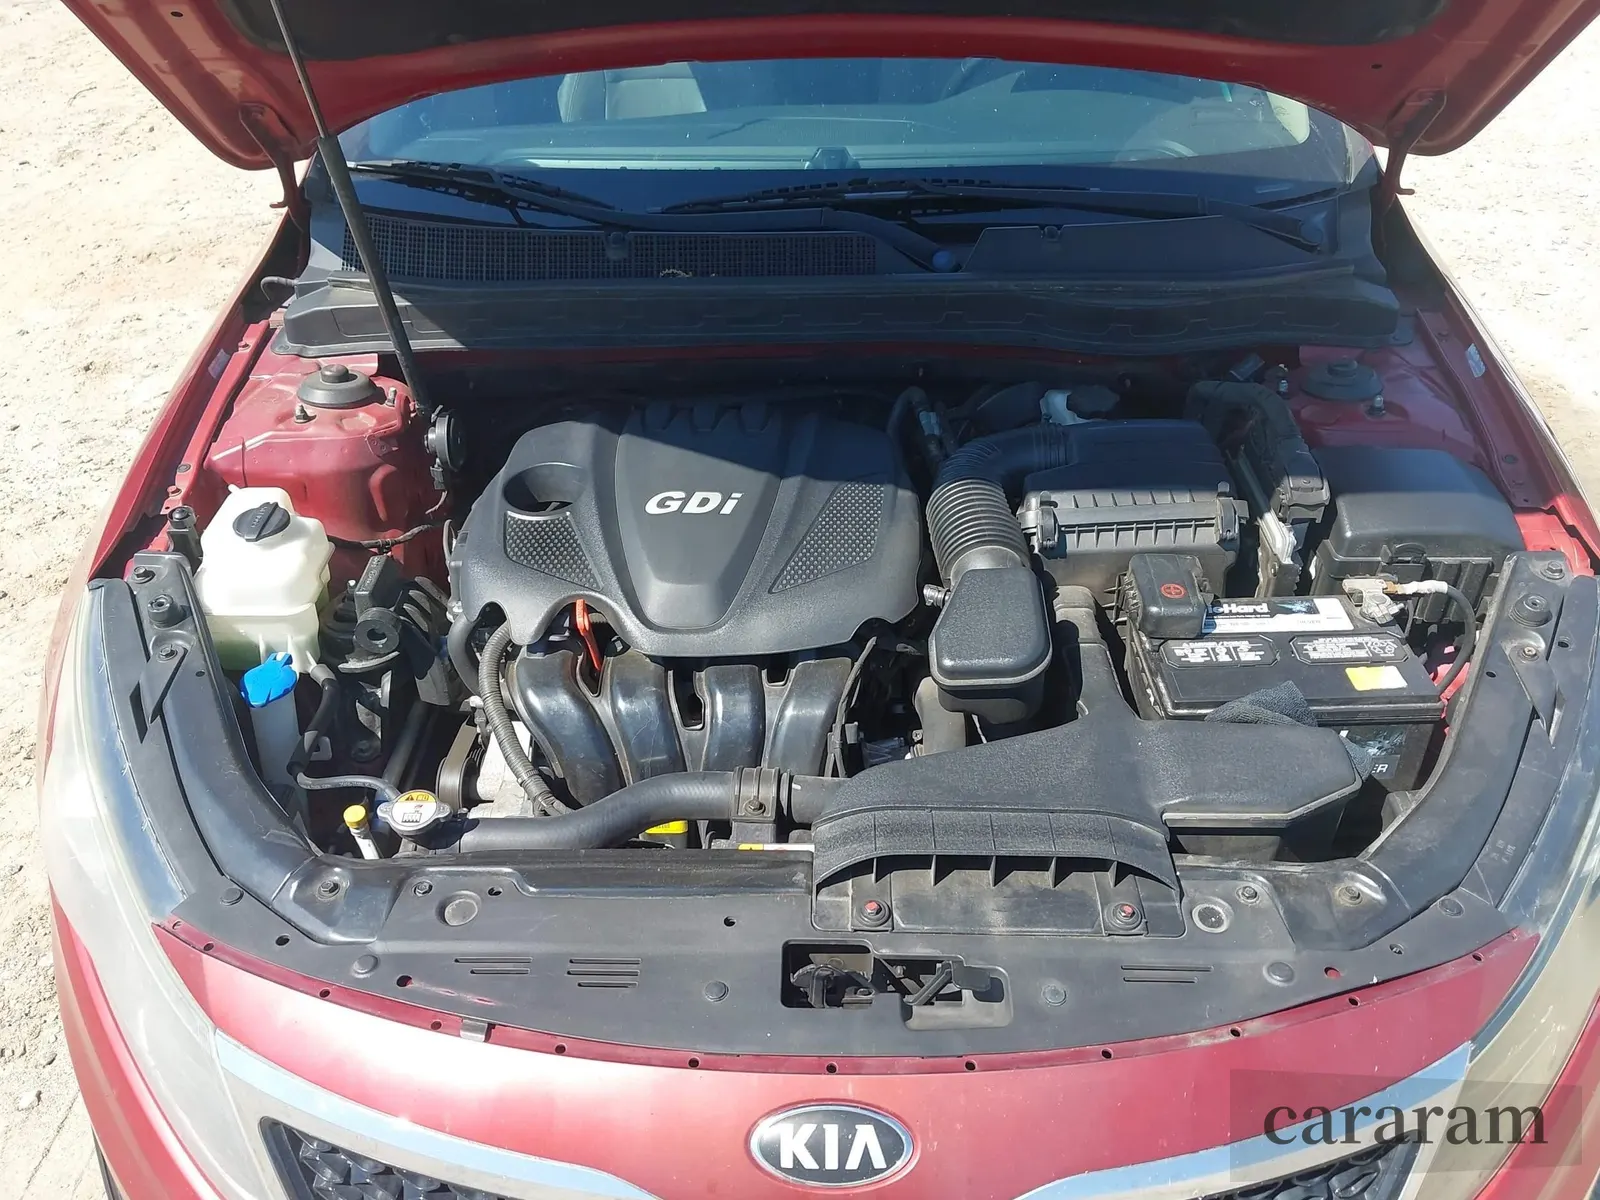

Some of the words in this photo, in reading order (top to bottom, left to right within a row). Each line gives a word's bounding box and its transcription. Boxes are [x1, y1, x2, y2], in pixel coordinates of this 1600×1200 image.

[644, 491, 744, 515] GDi
[1207, 603, 1269, 613] ieHard
[779, 1123, 888, 1170] KIA
